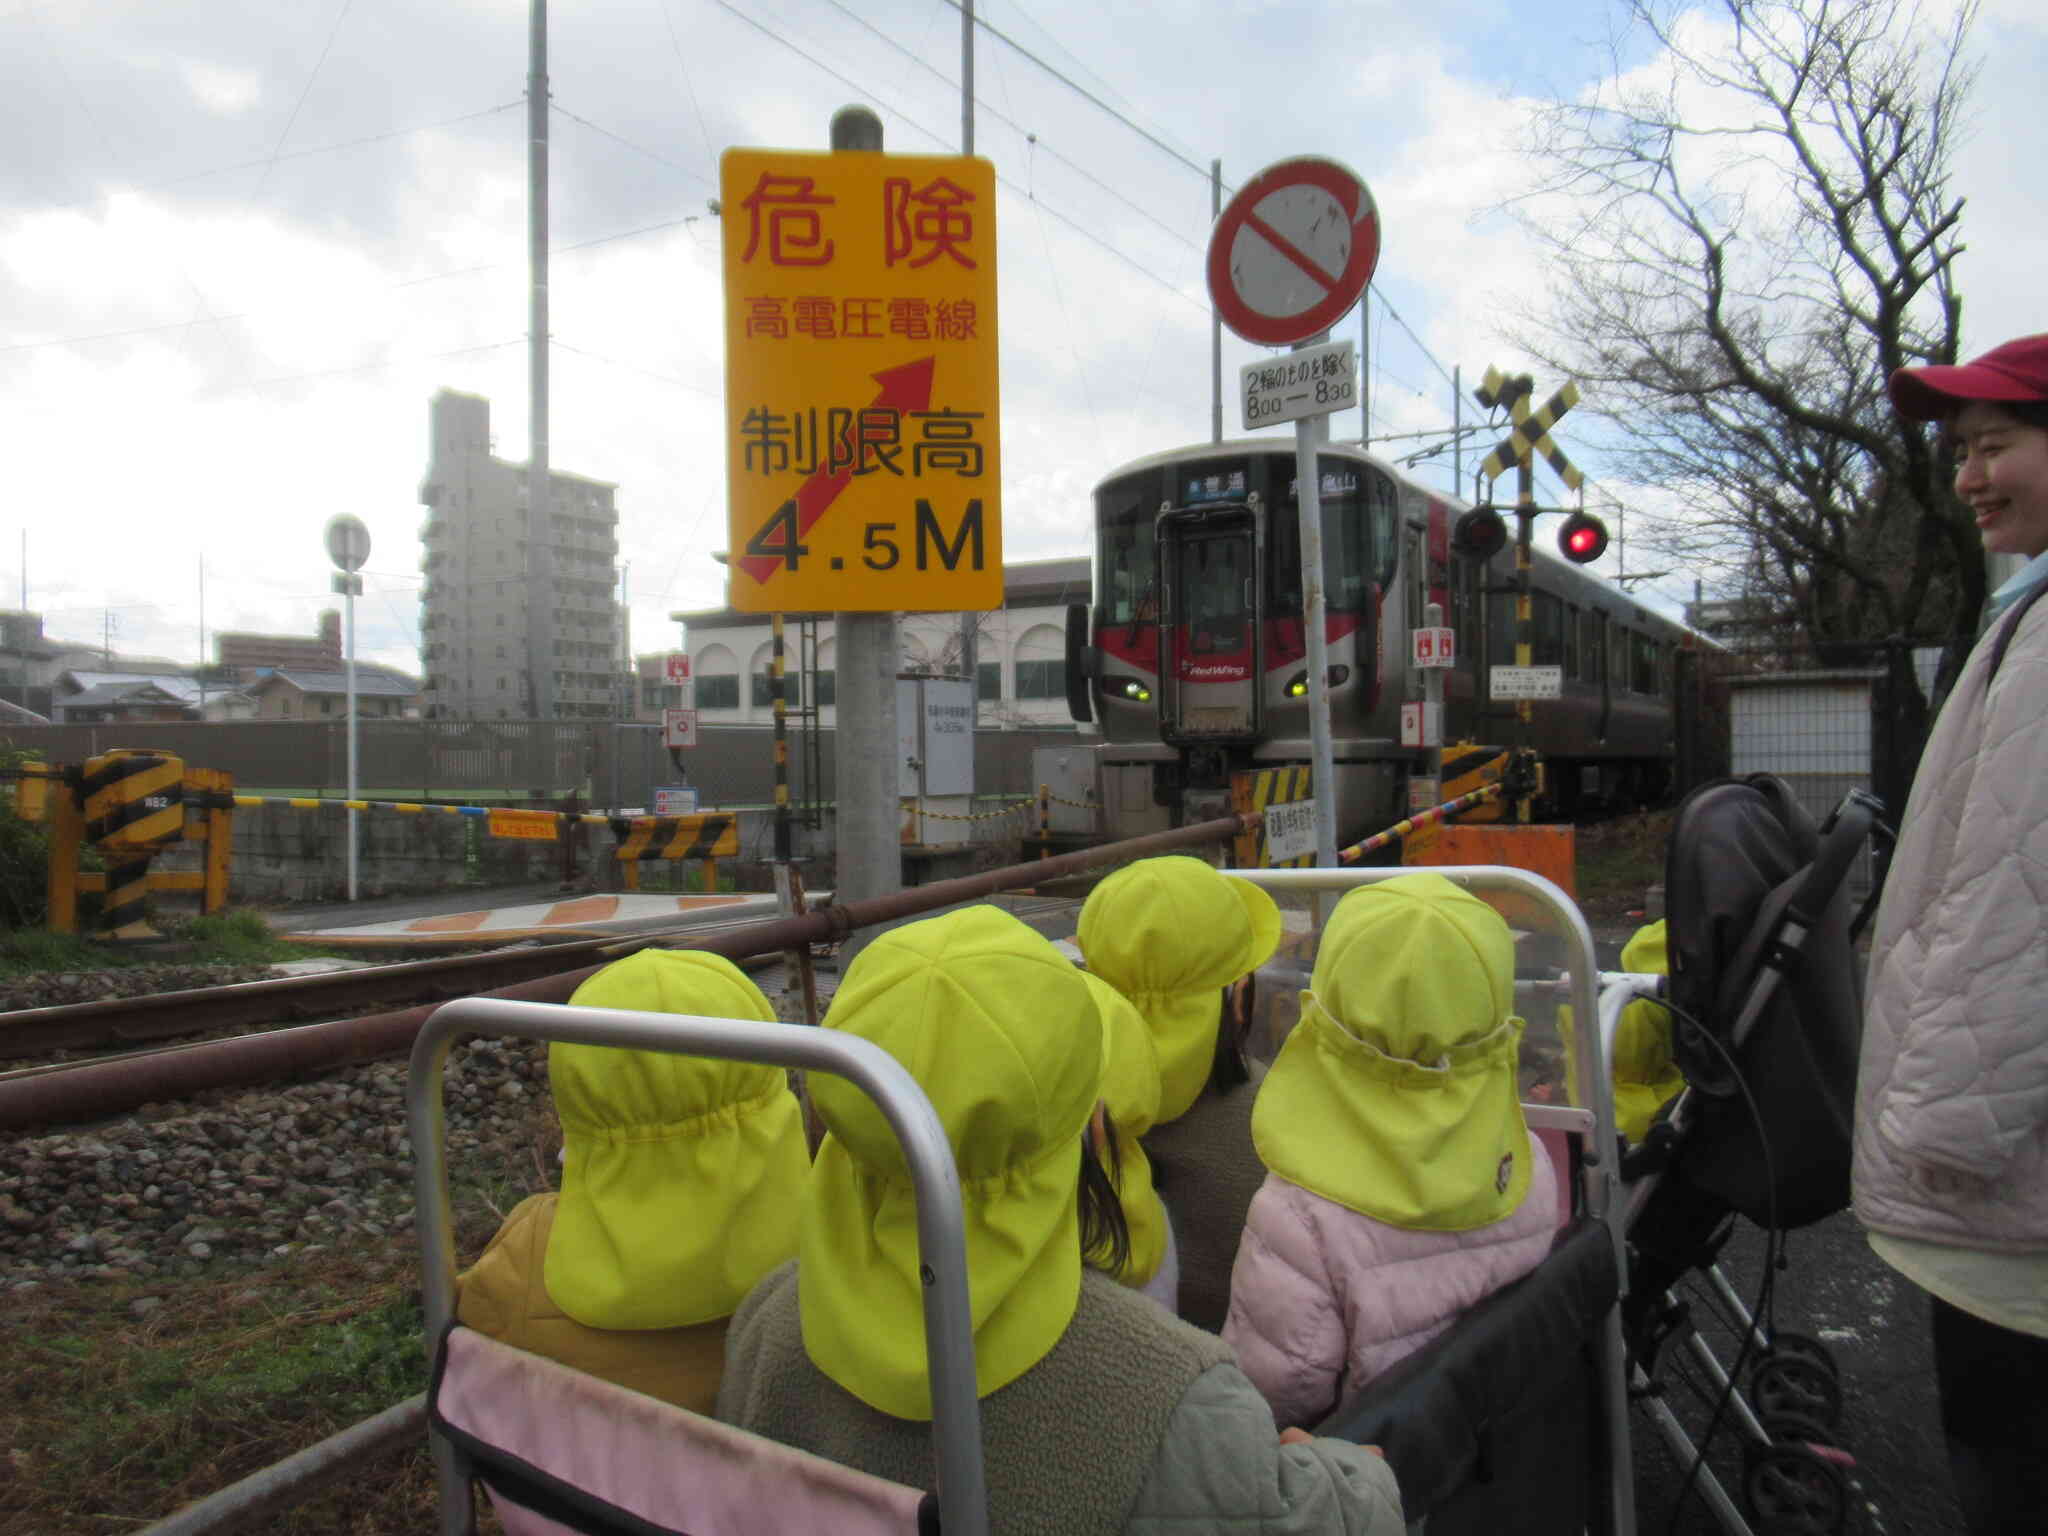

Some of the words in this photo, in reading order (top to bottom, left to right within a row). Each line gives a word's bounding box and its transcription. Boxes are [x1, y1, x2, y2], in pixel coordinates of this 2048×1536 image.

[741, 171, 977, 270] 危険
[743, 296, 978, 342] 高電圧電線
[741, 405, 985, 478] 制限高
[745, 498, 984, 572] 4.5M
